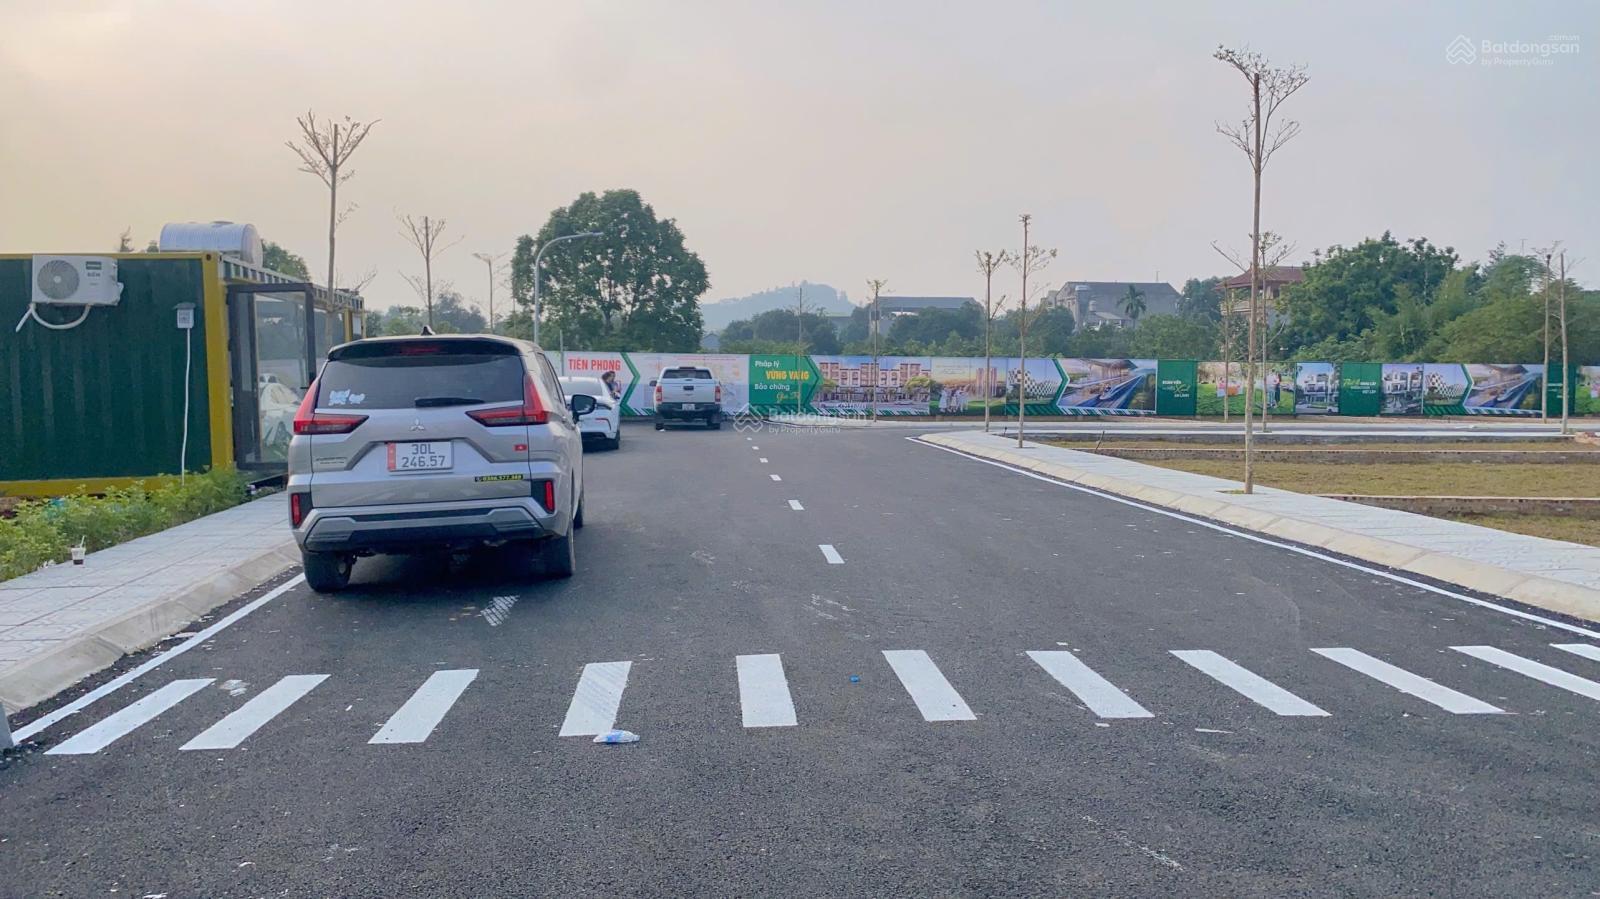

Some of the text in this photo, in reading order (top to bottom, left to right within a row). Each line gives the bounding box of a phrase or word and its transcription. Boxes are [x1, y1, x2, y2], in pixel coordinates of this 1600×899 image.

[591, 359, 621, 371] PHONG
[411, 443, 436, 455] 30L
[401, 455, 446, 468] 246.57
